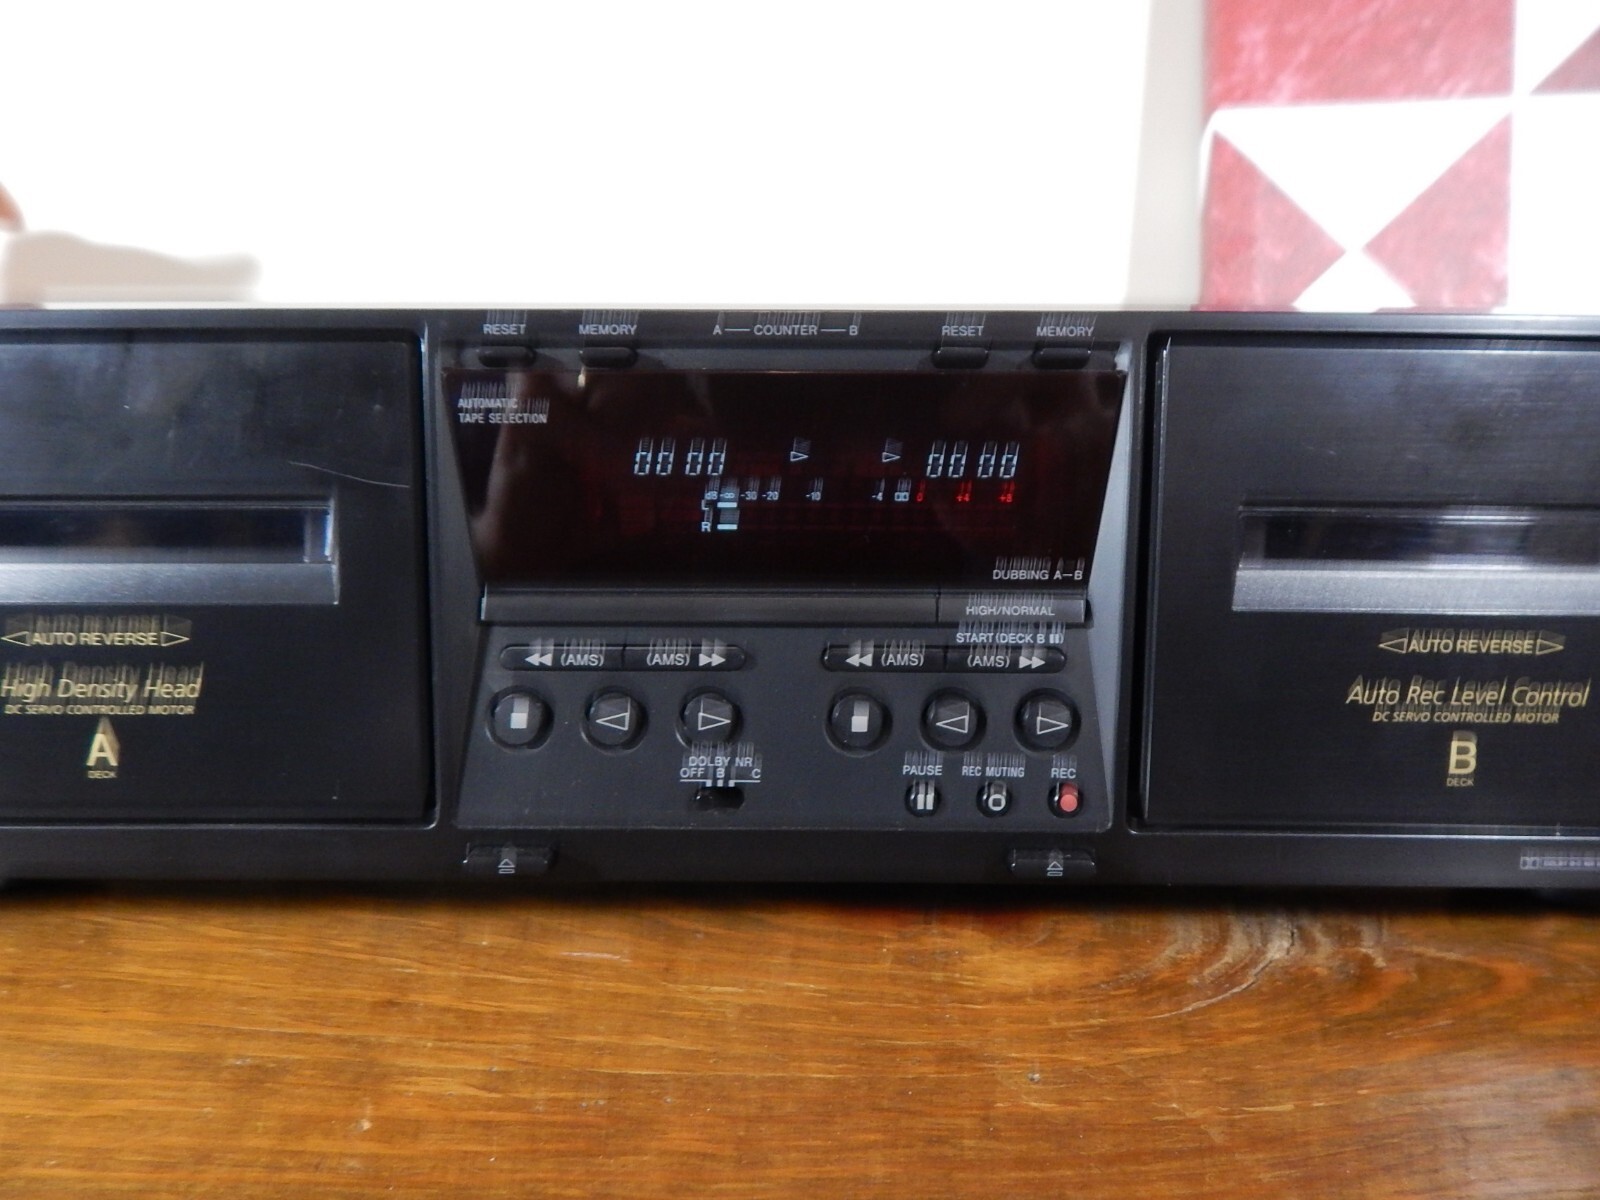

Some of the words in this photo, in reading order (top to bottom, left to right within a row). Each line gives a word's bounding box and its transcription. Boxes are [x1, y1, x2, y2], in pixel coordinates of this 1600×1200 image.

[483, 324, 527, 336] RESET
[578, 324, 637, 336] MEMORY
[712, 324, 723, 336] A
[753, 324, 818, 336] COUNTER
[849, 324, 859, 336] B
[941, 325, 984, 337] RESET
[1036, 326, 1094, 338] MEMORY
[457, 397, 518, 410] AUTOMATIC
[458, 412, 485, 424] TAPE
[488, 412, 547, 424] SELECTION
[992, 569, 1049, 580] DUBBING
[966, 606, 1055, 616] HIGH/NORMAL
[32, 632, 77, 646] AUTO
[80, 632, 159, 647] REVERSE
[956, 632, 993, 643] START
[1408, 639, 1453, 654] AUTO
[1456, 639, 1534, 655] REVERSE
[560, 653, 604, 667] (AMS)
[646, 653, 690, 667] (AMS)
[881, 653, 924, 667] (AMS)
[967, 655, 1010, 668] (AMS)
[0, 677, 51, 703] High
[56, 678, 138, 703] Density
[143, 677, 202, 698] Head
[1346, 686, 1399, 705] Auto
[1405, 686, 1445, 705] Rec
[1450, 686, 1507, 707] Level
[1511, 686, 1590, 707] Control
[148, 704, 195, 715] MOTOR
[1372, 711, 1389, 722] DC
[1392, 711, 1431, 722] SERVO
[1433, 711, 1512, 723] CONTROLLED
[1514, 712, 1560, 723] MOTOR
[86, 733, 119, 767] A
[689, 756, 731, 767] DOLBY
[735, 757, 753, 767] NR
[1449, 740, 1477, 774] B
[680, 767, 705, 778] OFF
[751, 768, 761, 779] C
[902, 765, 943, 776] PAUSE
[962, 765, 981, 777] REC
[986, 765, 1025, 778] MUTING
[1051, 768, 1077, 779] REC
